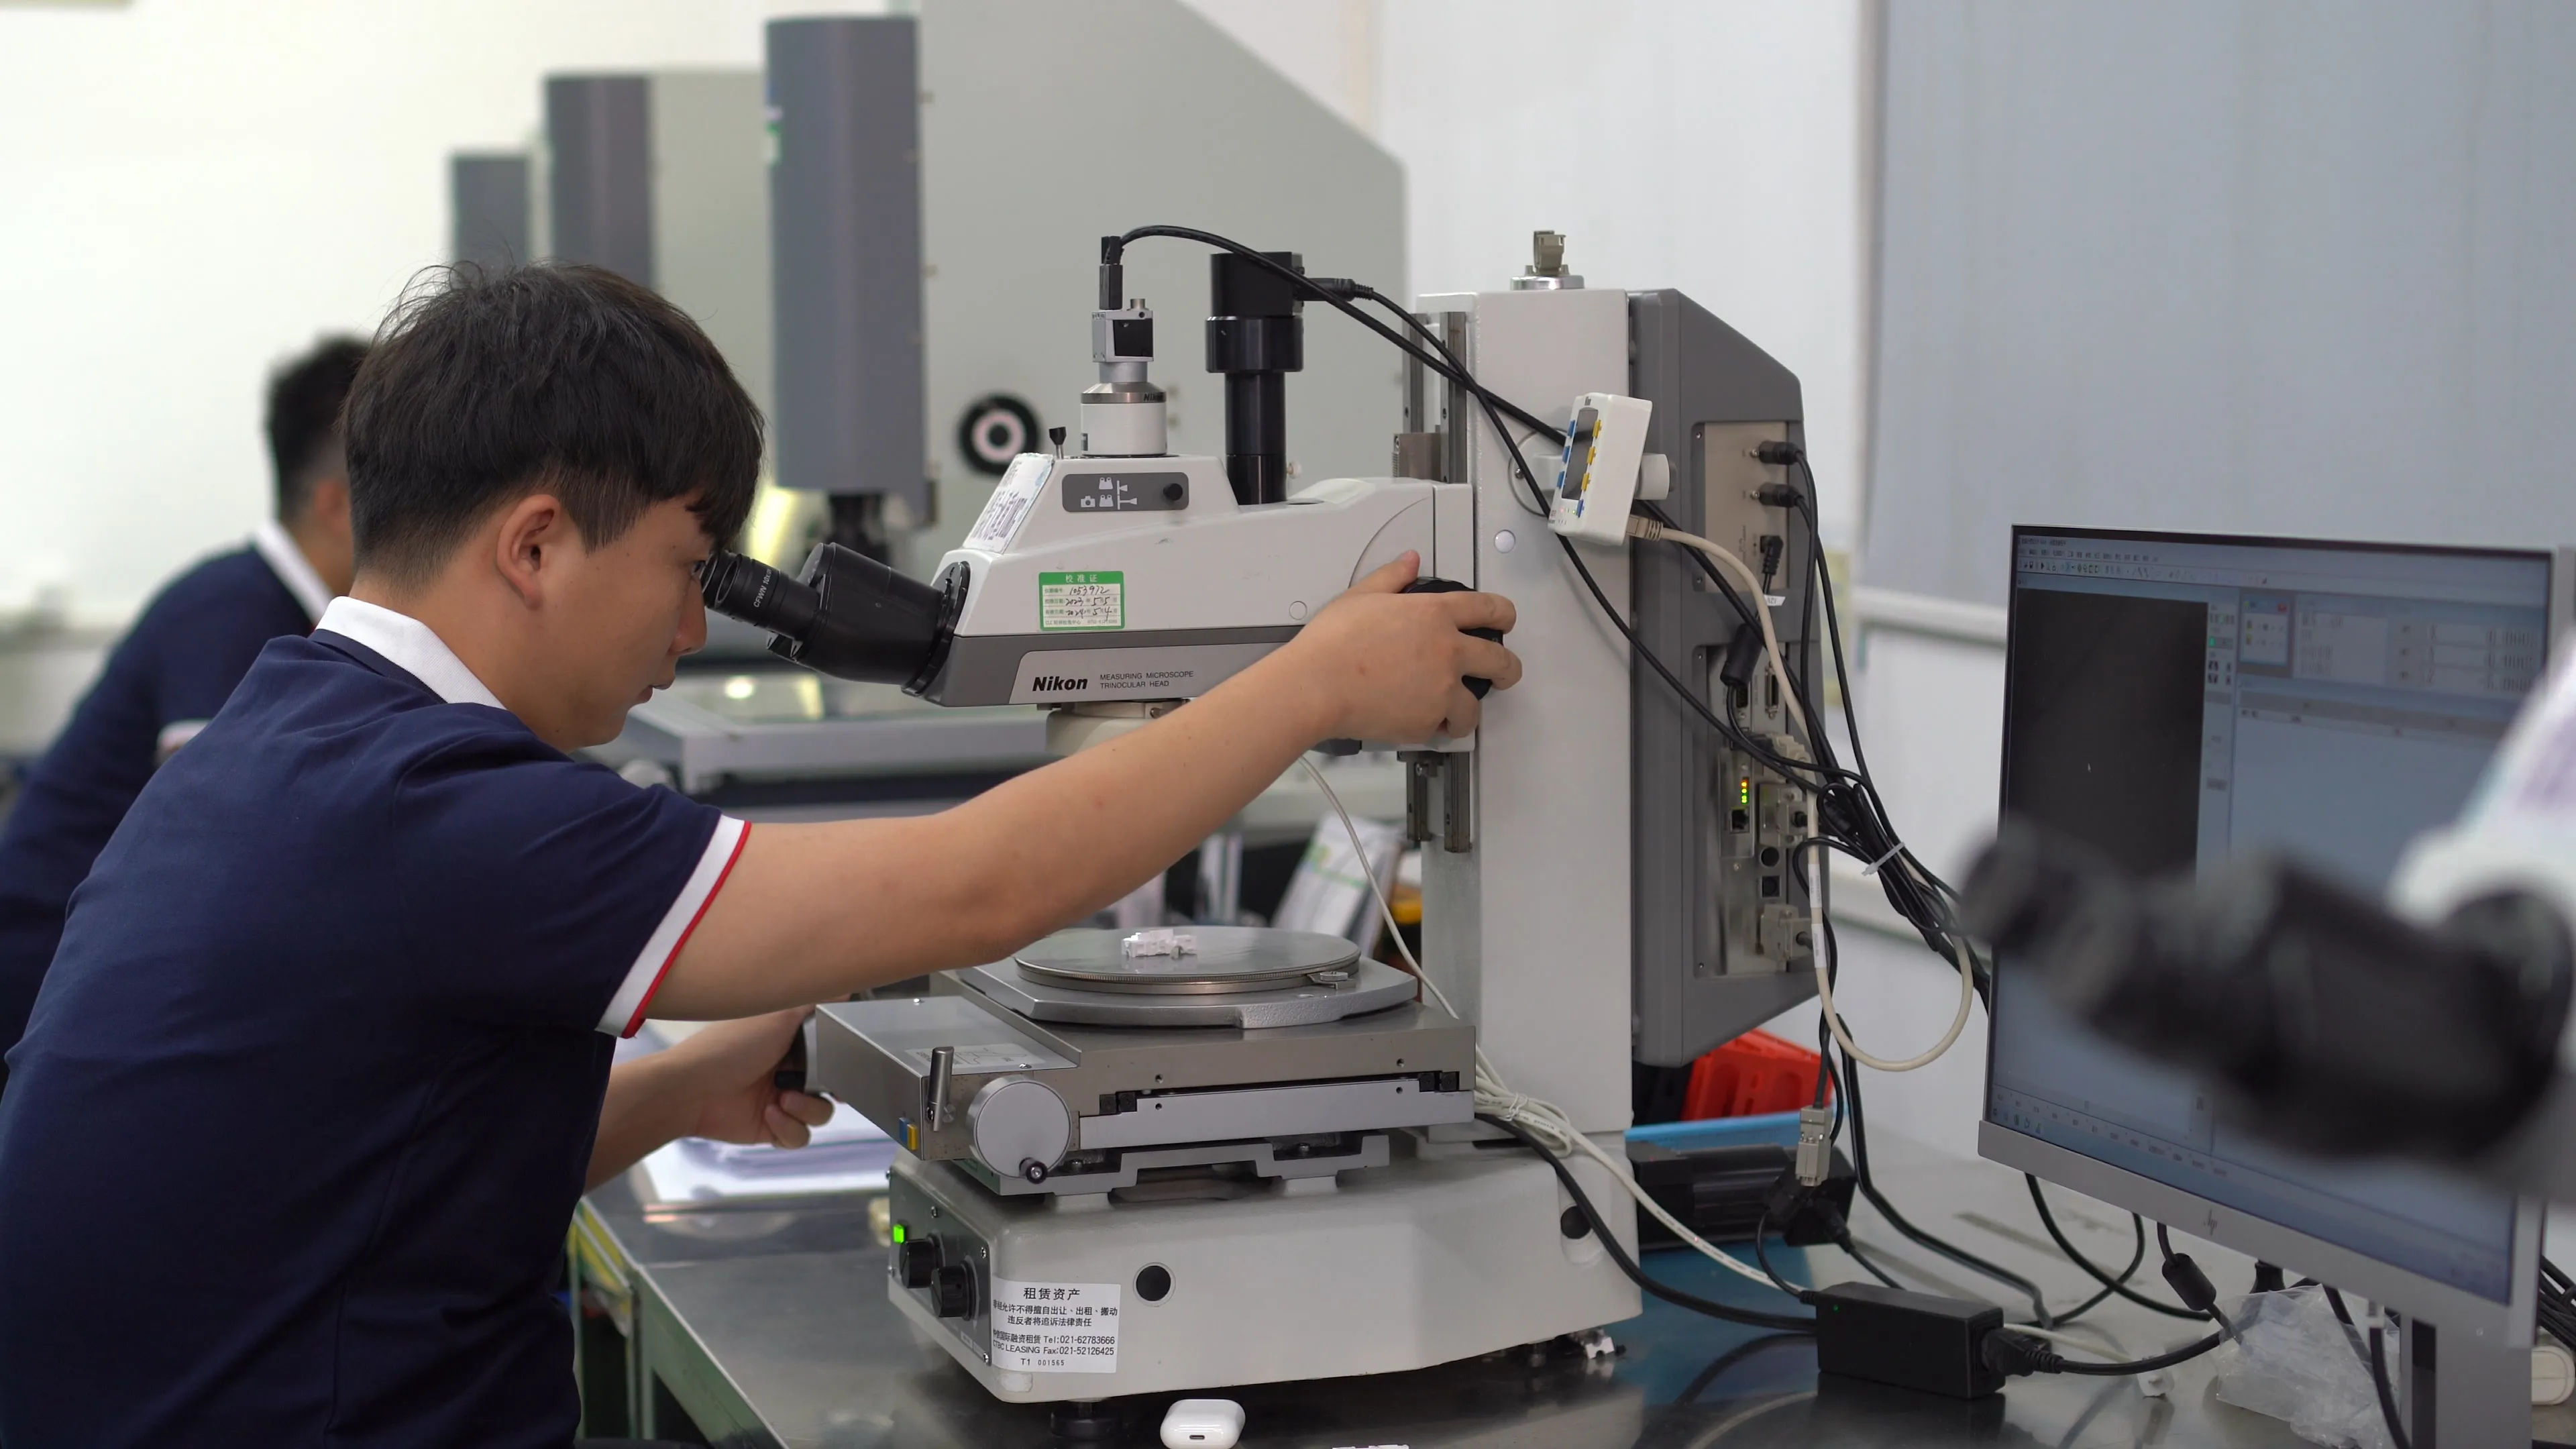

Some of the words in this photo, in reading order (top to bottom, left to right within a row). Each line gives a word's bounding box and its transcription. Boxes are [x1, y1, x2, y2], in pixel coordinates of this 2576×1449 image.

[1065, 574, 1097, 583] 校准证
[753, 585, 767, 608] CFWN
[1146, 671, 1194, 679] MICROSCOPE
[1032, 676, 1088, 691] Nikon
[1100, 681, 1146, 689] TRINOCULAR
[1023, 1287, 1081, 1301] 租赁资产
[1007, 1315, 1092, 1327] 违反者将追诉法律责任
[1006, 1344, 1040, 1354] LEASING
